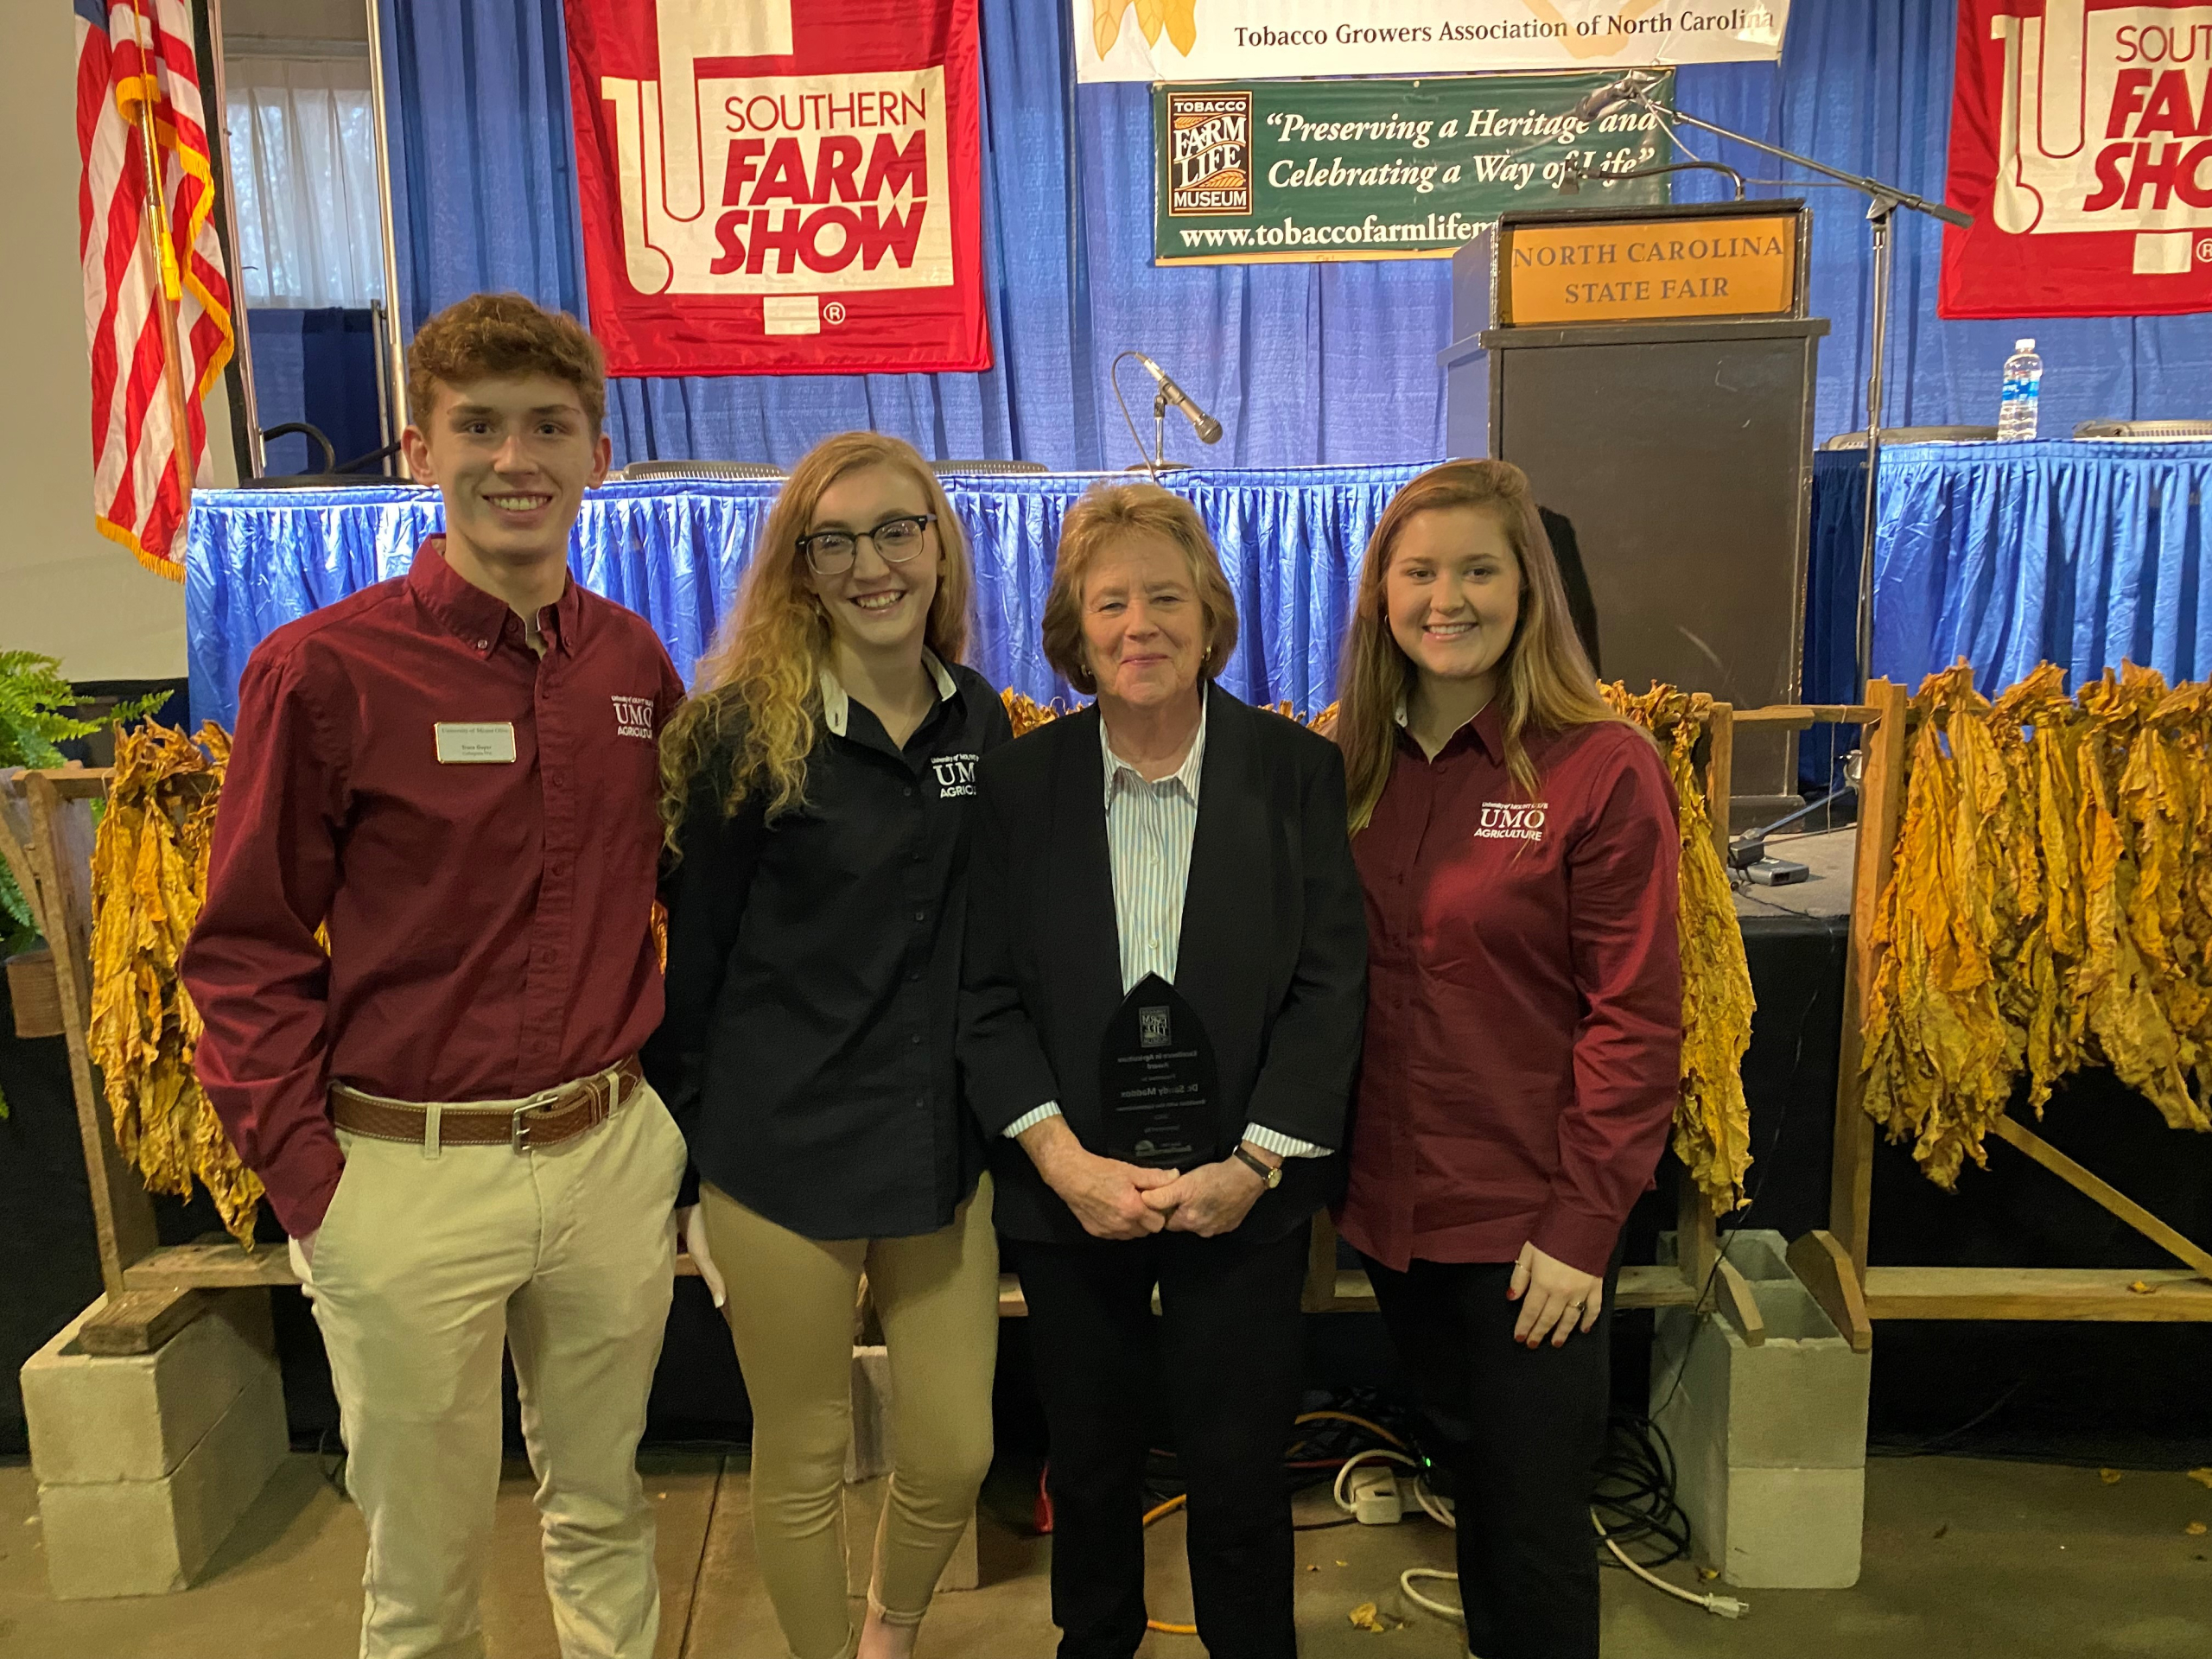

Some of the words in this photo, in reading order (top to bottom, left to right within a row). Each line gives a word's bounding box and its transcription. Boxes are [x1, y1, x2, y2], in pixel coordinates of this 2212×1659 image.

[1234, 25, 1328, 47] Tobacco
[1336, 23, 1433, 44] Growers
[1438, 19, 1567, 41] Association
[1576, 15, 1603, 36] of
[1607, 12, 1672, 35] North
[1680, 8, 1774, 31] Carolina
[724, 87, 926, 133] SOUTHERN
[1173, 101, 1247, 113] TOBACCO
[2106, 67, 2212, 139] FA
[1173, 116, 1247, 162] FARM
[1266, 112, 1434, 149] “Preserving
[1438, 118, 1459, 138] a
[1465, 109, 1590, 144] Heritage
[1598, 111, 1659, 133] and
[721, 129, 928, 207] FARM
[1179, 143, 1241, 188] LIFE
[1268, 156, 1438, 194] Celebrating
[1441, 164, 1462, 184] a
[1472, 153, 1536, 191] Way
[1173, 191, 1247, 207] MUSEUM
[709, 200, 928, 276] SHOW
[1513, 243, 1616, 268] NORTH
[1627, 236, 1784, 263] CAROLINA
[1565, 281, 1650, 305] STATE
[1662, 276, 1729, 300] FAIR
[1474, 828, 1543, 842] AGRICULTURE
[1480, 809, 1545, 830] UMO
